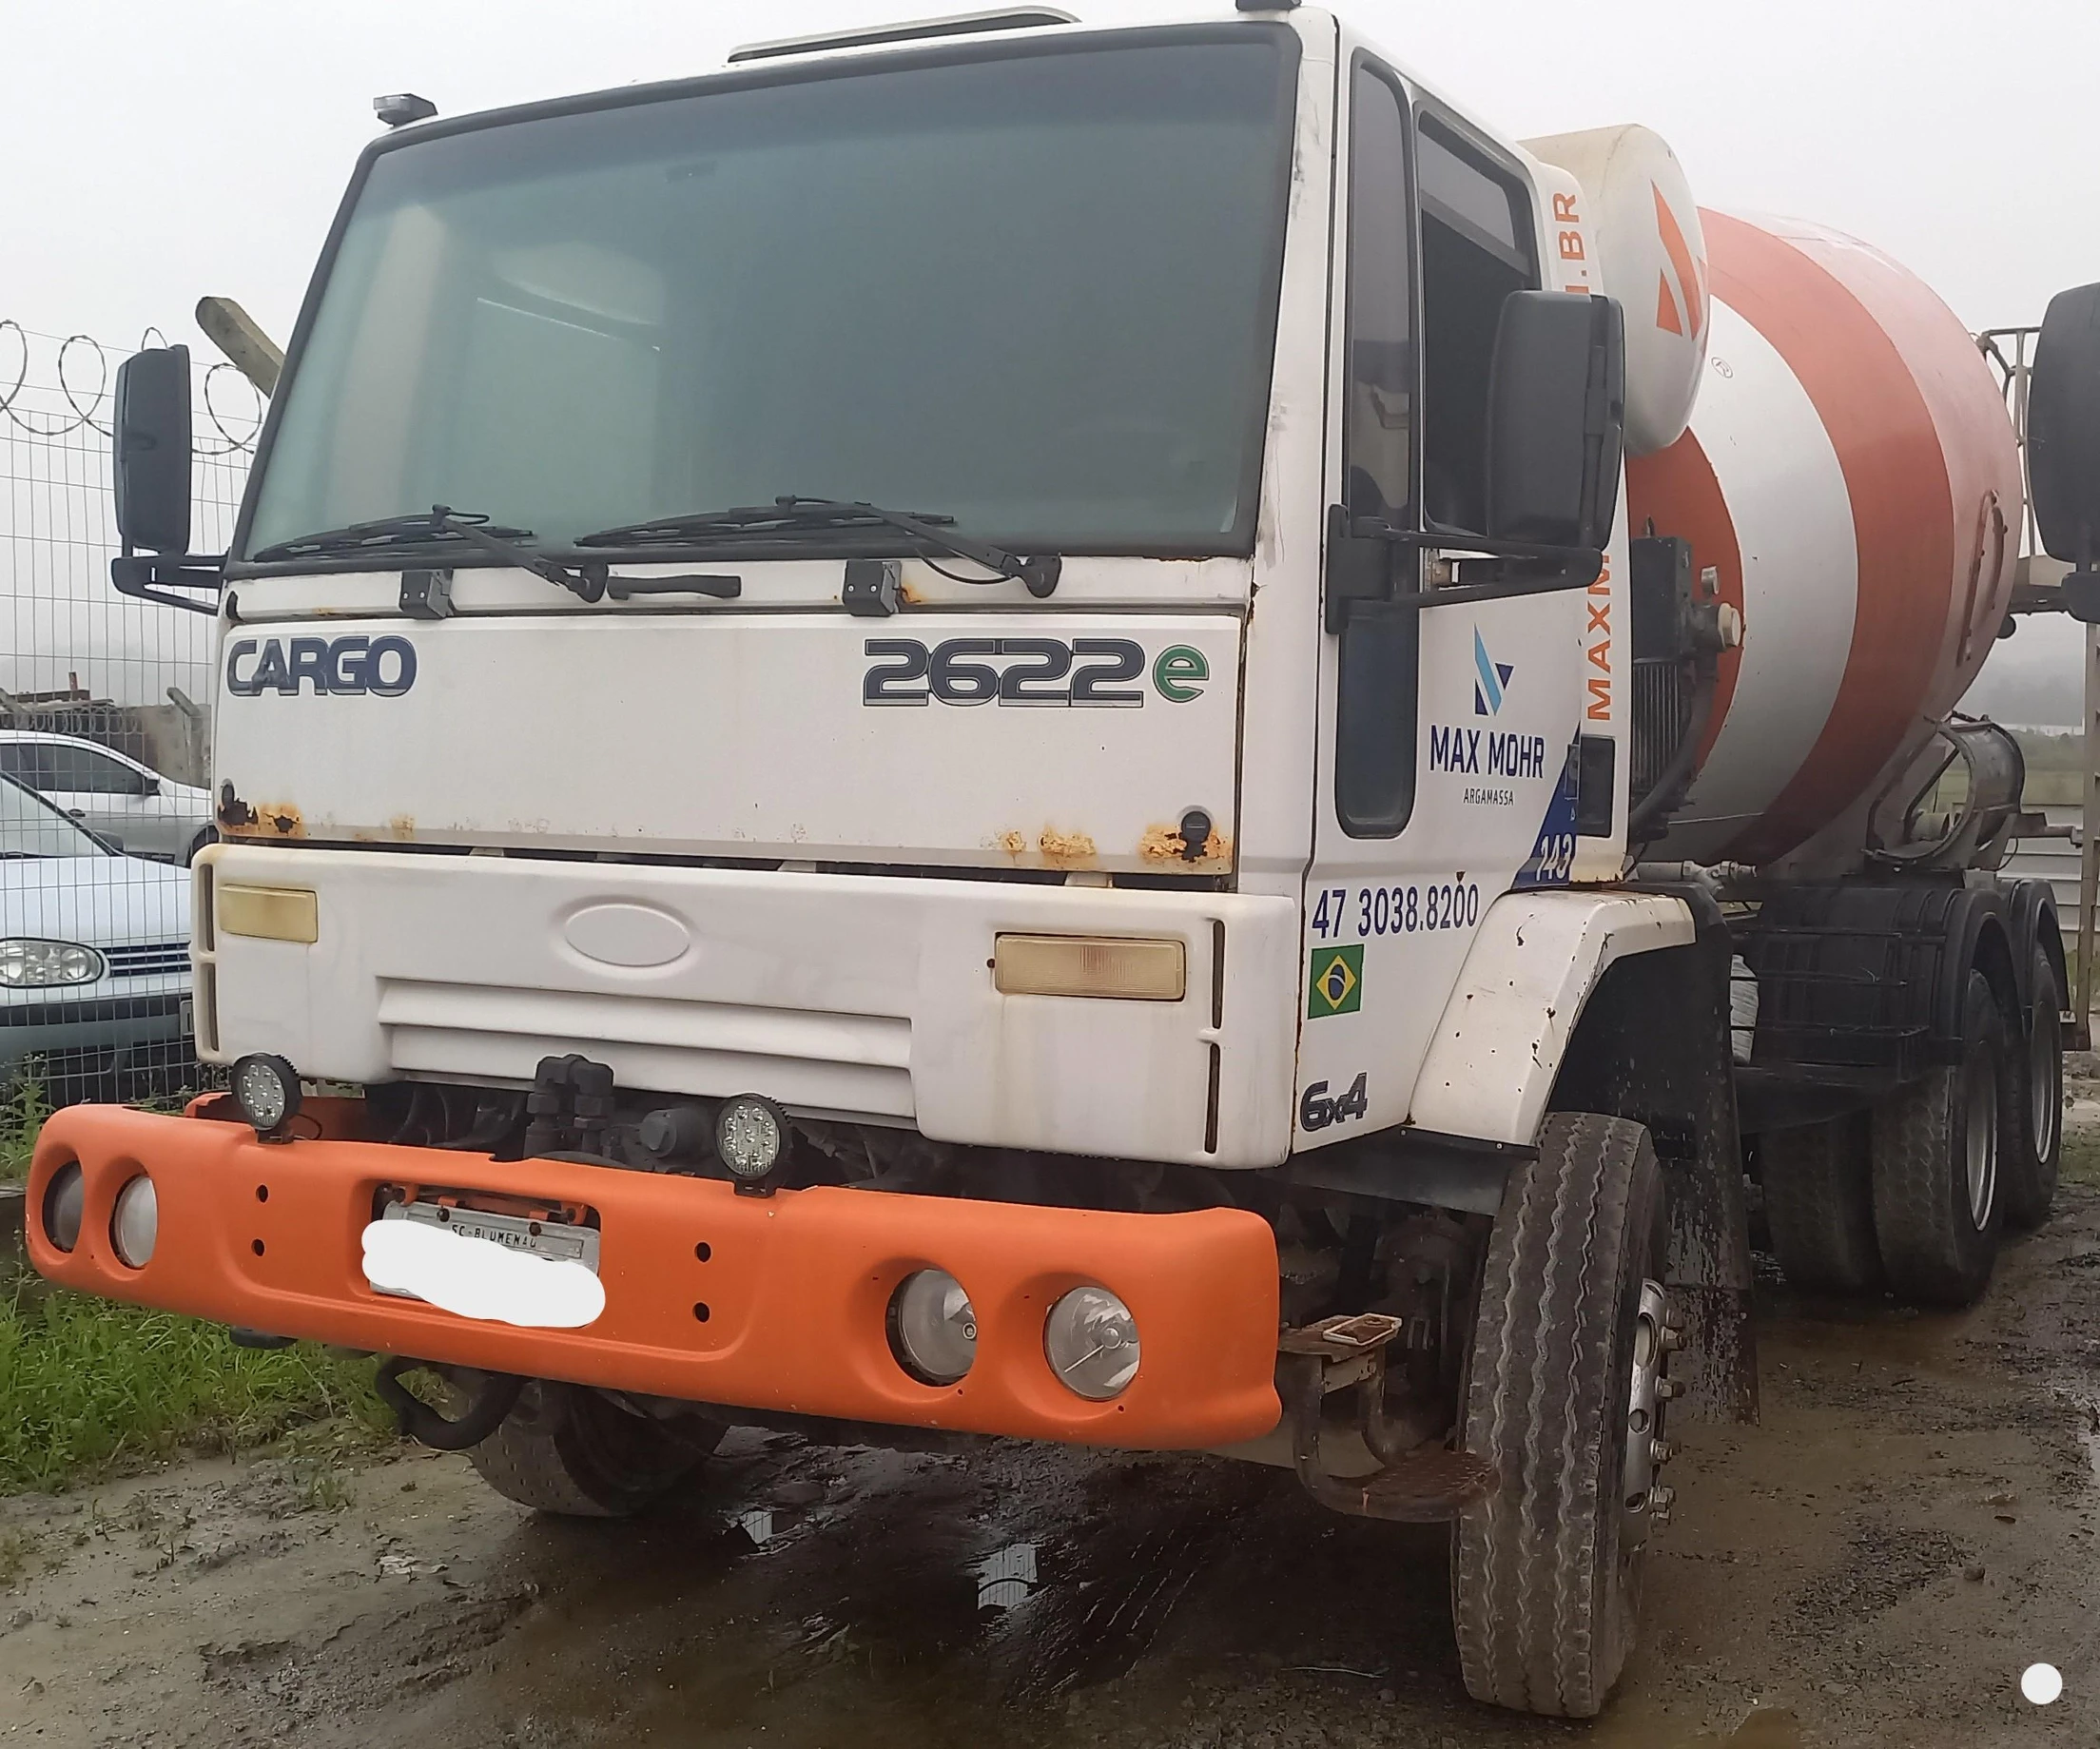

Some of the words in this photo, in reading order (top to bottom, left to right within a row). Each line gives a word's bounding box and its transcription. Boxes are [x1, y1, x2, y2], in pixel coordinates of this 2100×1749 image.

[1552, 192, 1590, 294] .BR
[227, 636, 418, 697] CARGO
[1429, 725, 1481, 774] MAX
[1488, 731, 1545, 778] MOHR
[1463, 788, 1514, 806] ARGAMASSA
[1536, 833, 1573, 881] 143
[1312, 889, 1347, 939] 47
[1357, 884, 1479, 937] 3038.8200
[1300, 1072, 1368, 1132] 6x4
